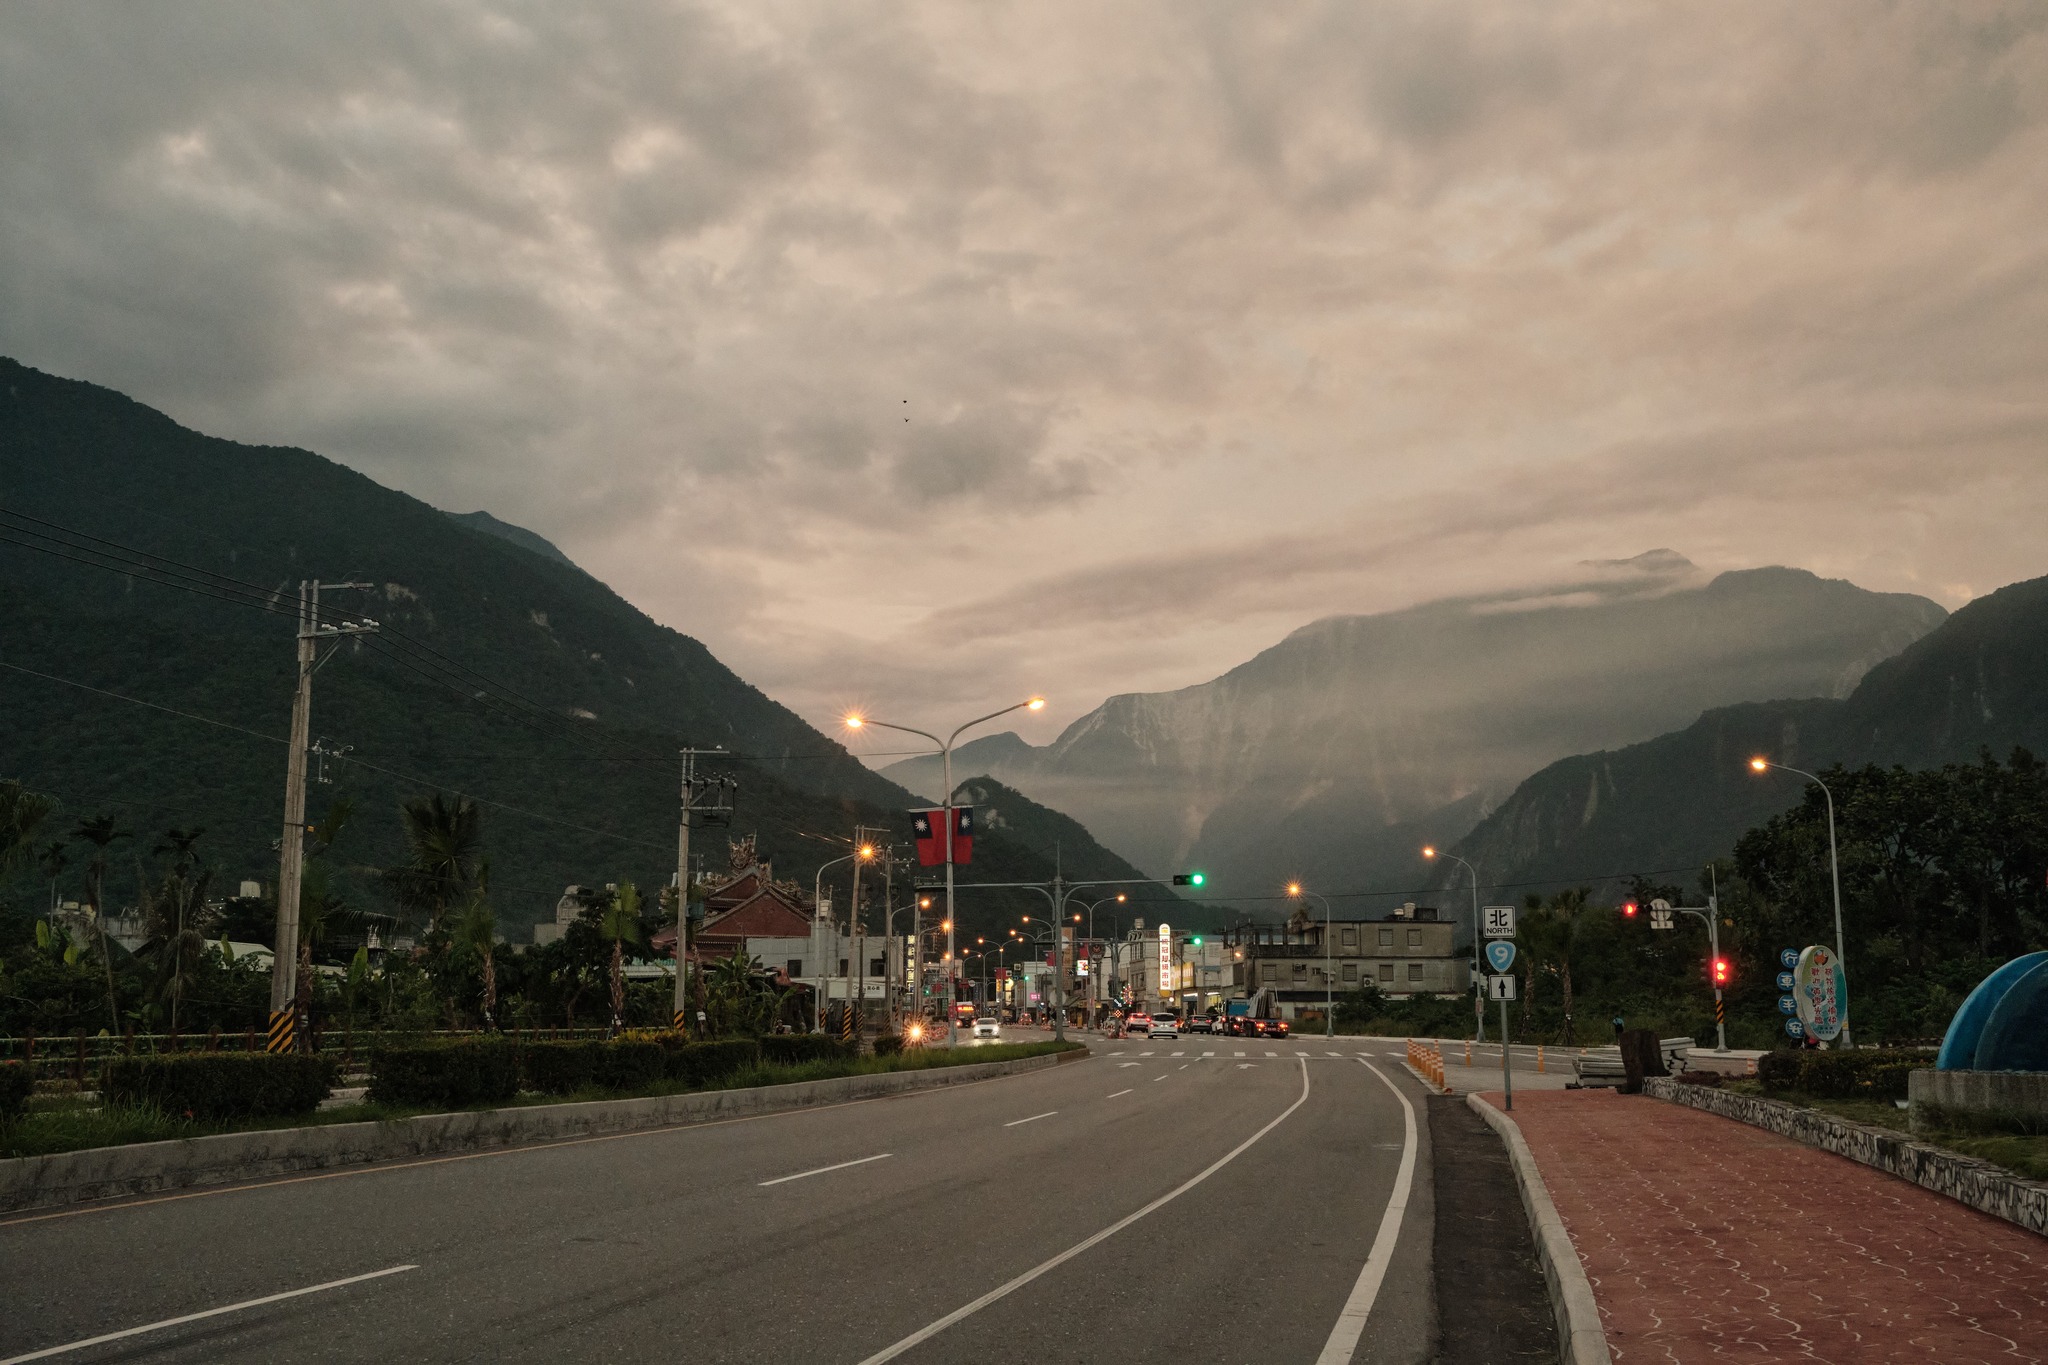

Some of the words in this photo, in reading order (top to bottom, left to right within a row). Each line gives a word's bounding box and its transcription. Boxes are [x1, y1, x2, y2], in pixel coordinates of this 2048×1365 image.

[1489, 910, 1508, 926] 北
[1494, 947, 1508, 963] 9
[1780, 952, 1803, 1035] 行車平安
